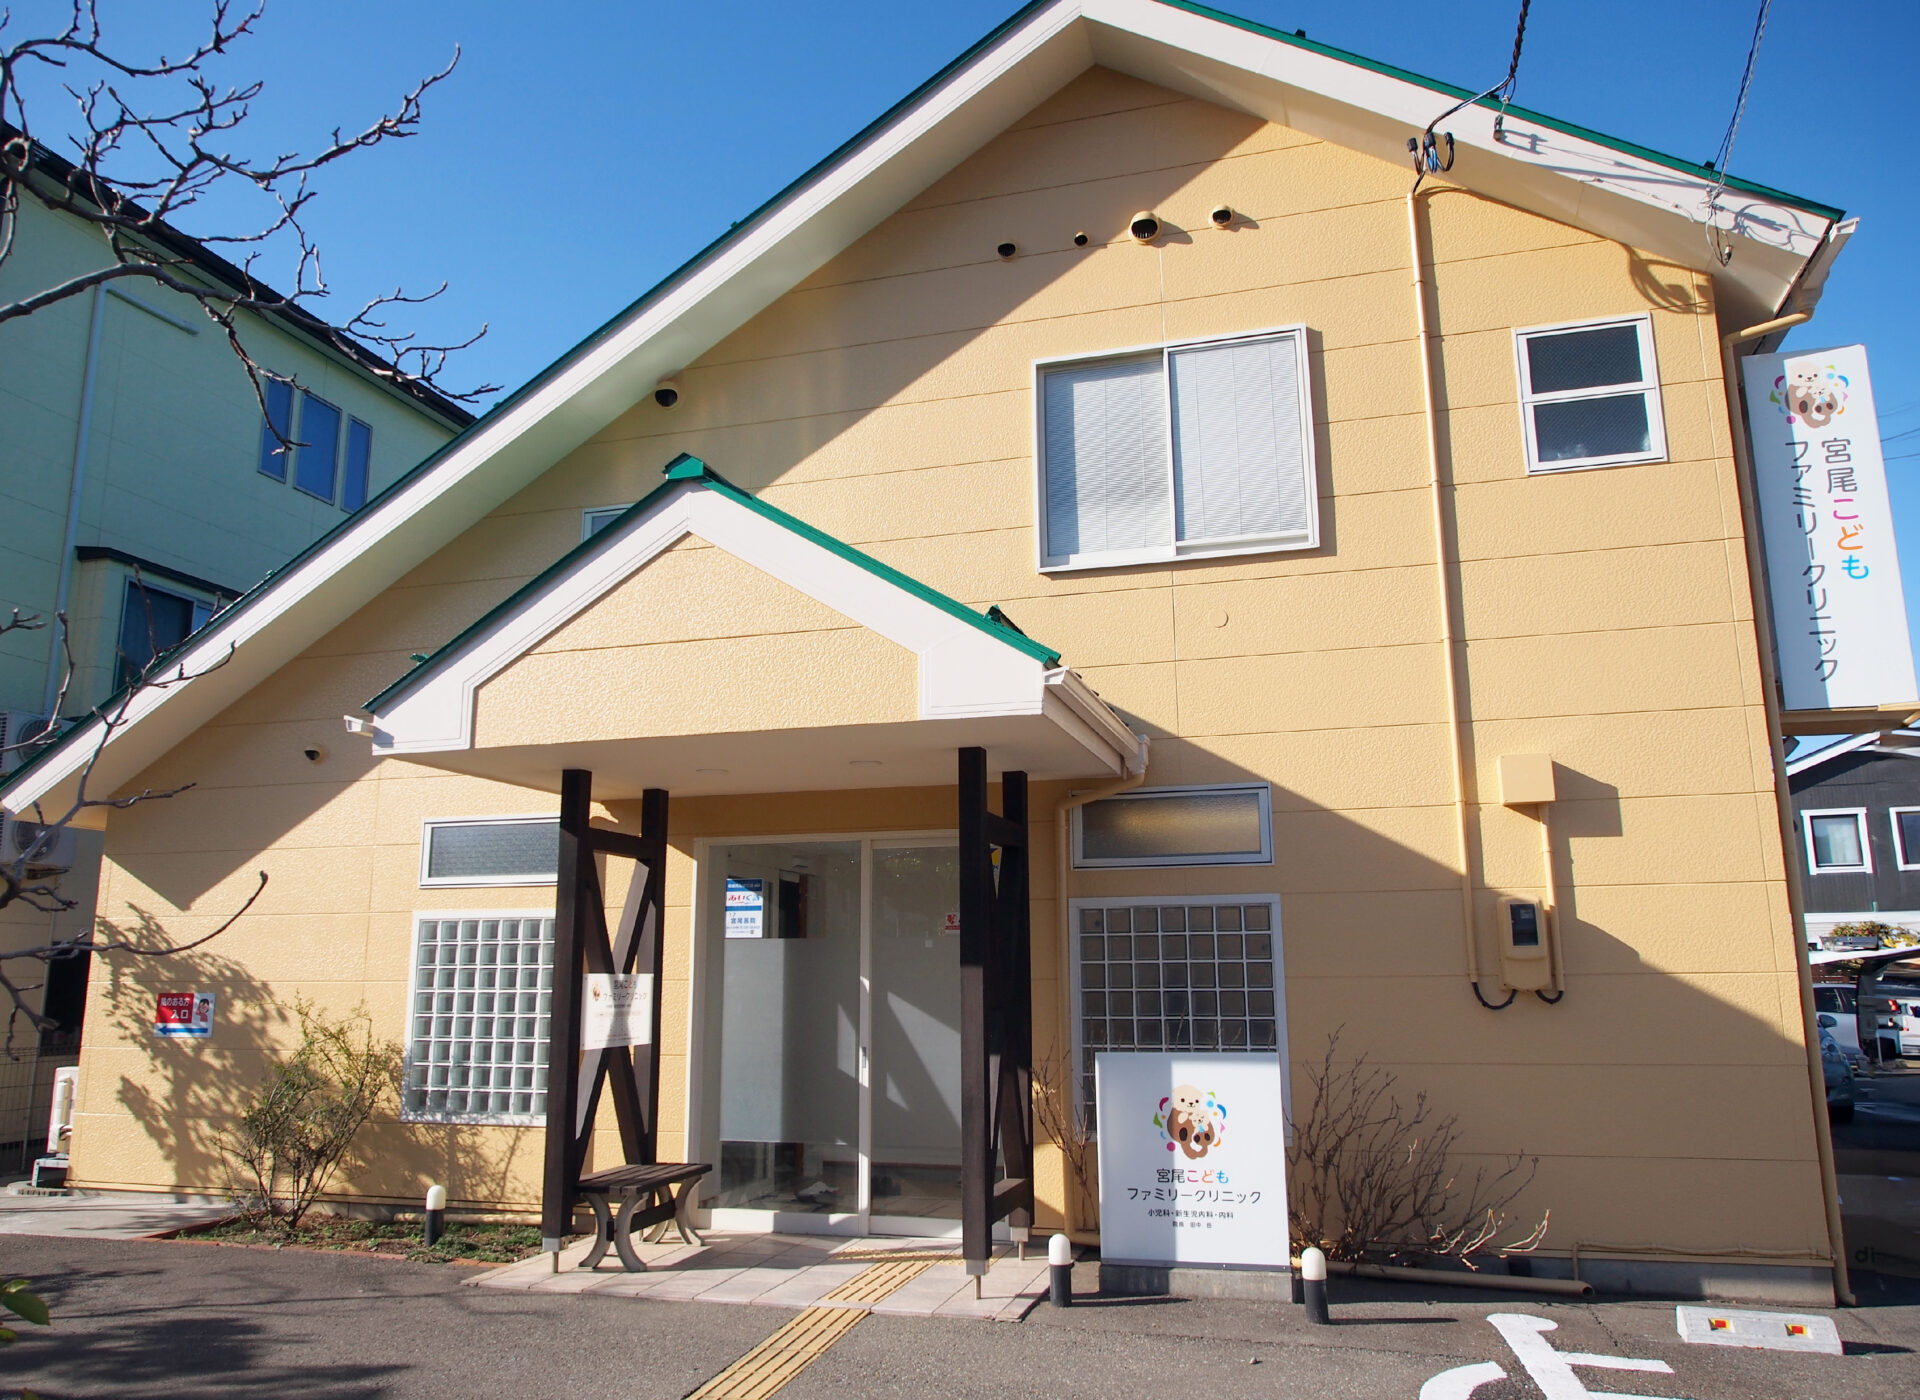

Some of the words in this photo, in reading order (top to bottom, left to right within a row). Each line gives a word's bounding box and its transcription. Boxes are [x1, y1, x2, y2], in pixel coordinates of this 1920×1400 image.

[1821, 437, 1869, 580] 宮尾こども
[1785, 440, 1838, 682] ファミリークリニック
[171, 1009, 188, 1019] 入口
[1156, 1168, 1229, 1184] 宮尾こども
[1127, 1187, 1261, 1204] ファミリークリニック
